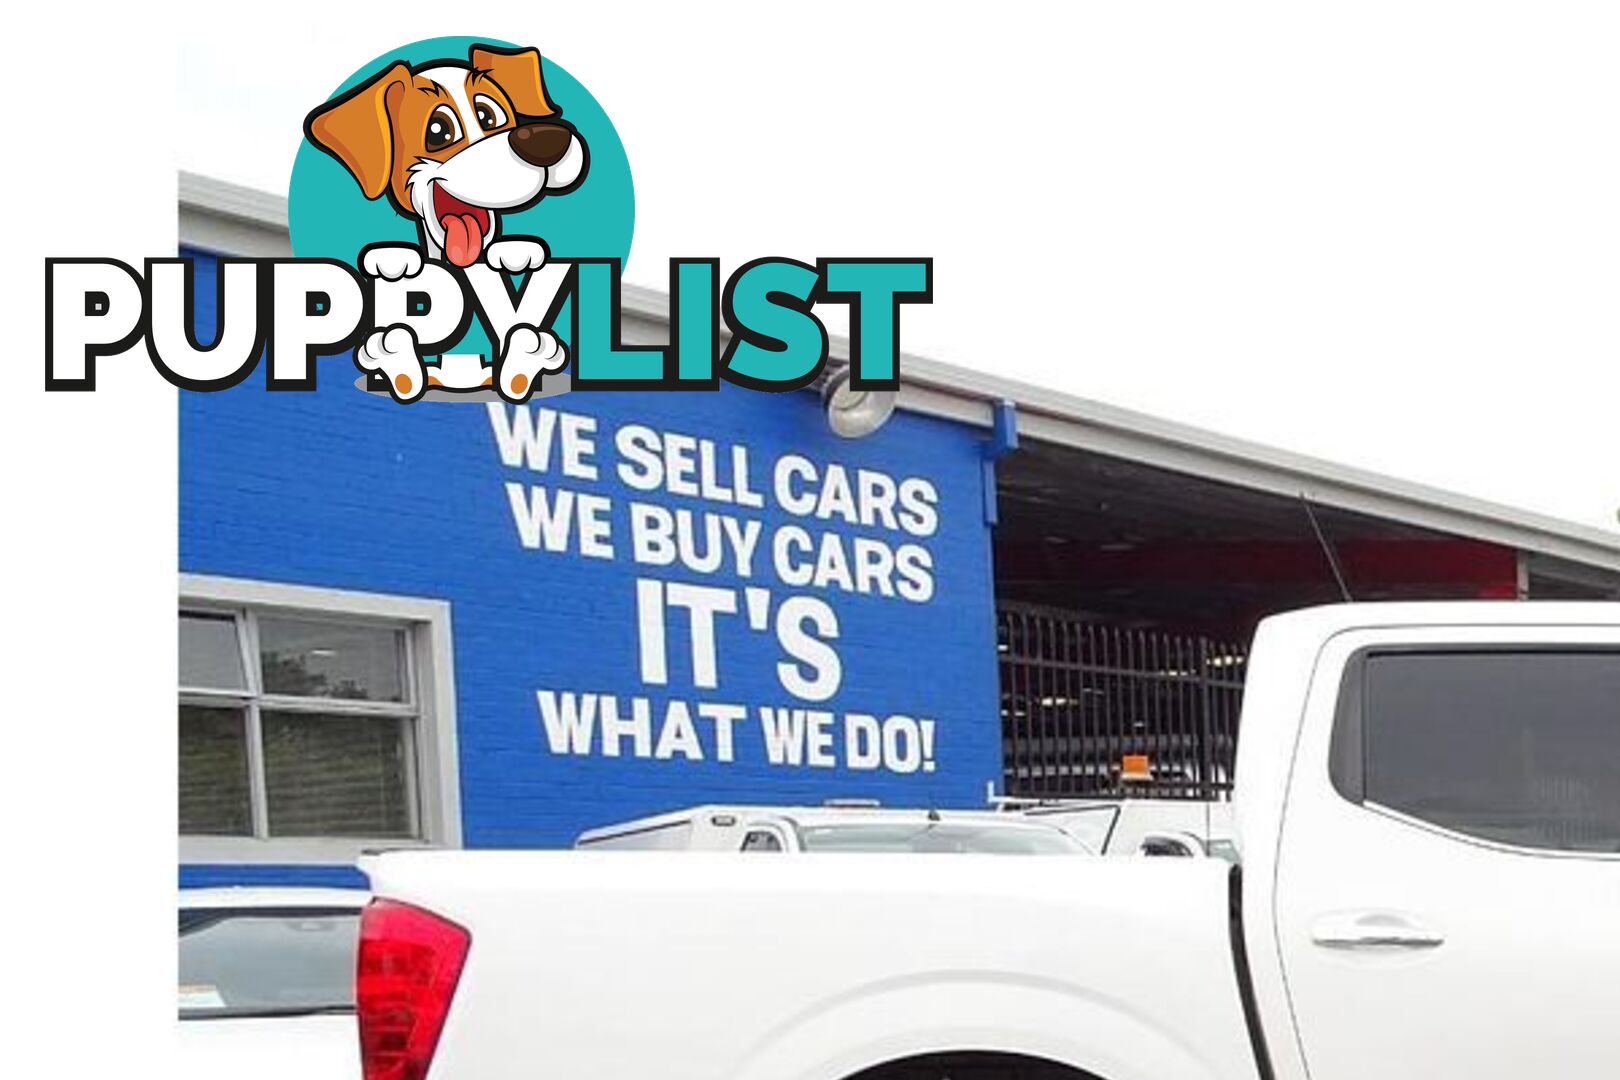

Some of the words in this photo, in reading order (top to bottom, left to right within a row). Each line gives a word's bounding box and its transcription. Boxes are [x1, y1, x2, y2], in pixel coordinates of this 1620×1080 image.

[486, 400, 597, 480] WE
[615, 425, 763, 508] SELL
[774, 454, 938, 536] CARS
[505, 482, 614, 560] WE
[630, 502, 761, 577] BUY
[773, 525, 935, 603] CARS
[636, 578, 841, 702] IT'S
[537, 690, 747, 763] WHAT
[759, 706, 834, 766] WE
[846, 714, 935, 775] DO!
